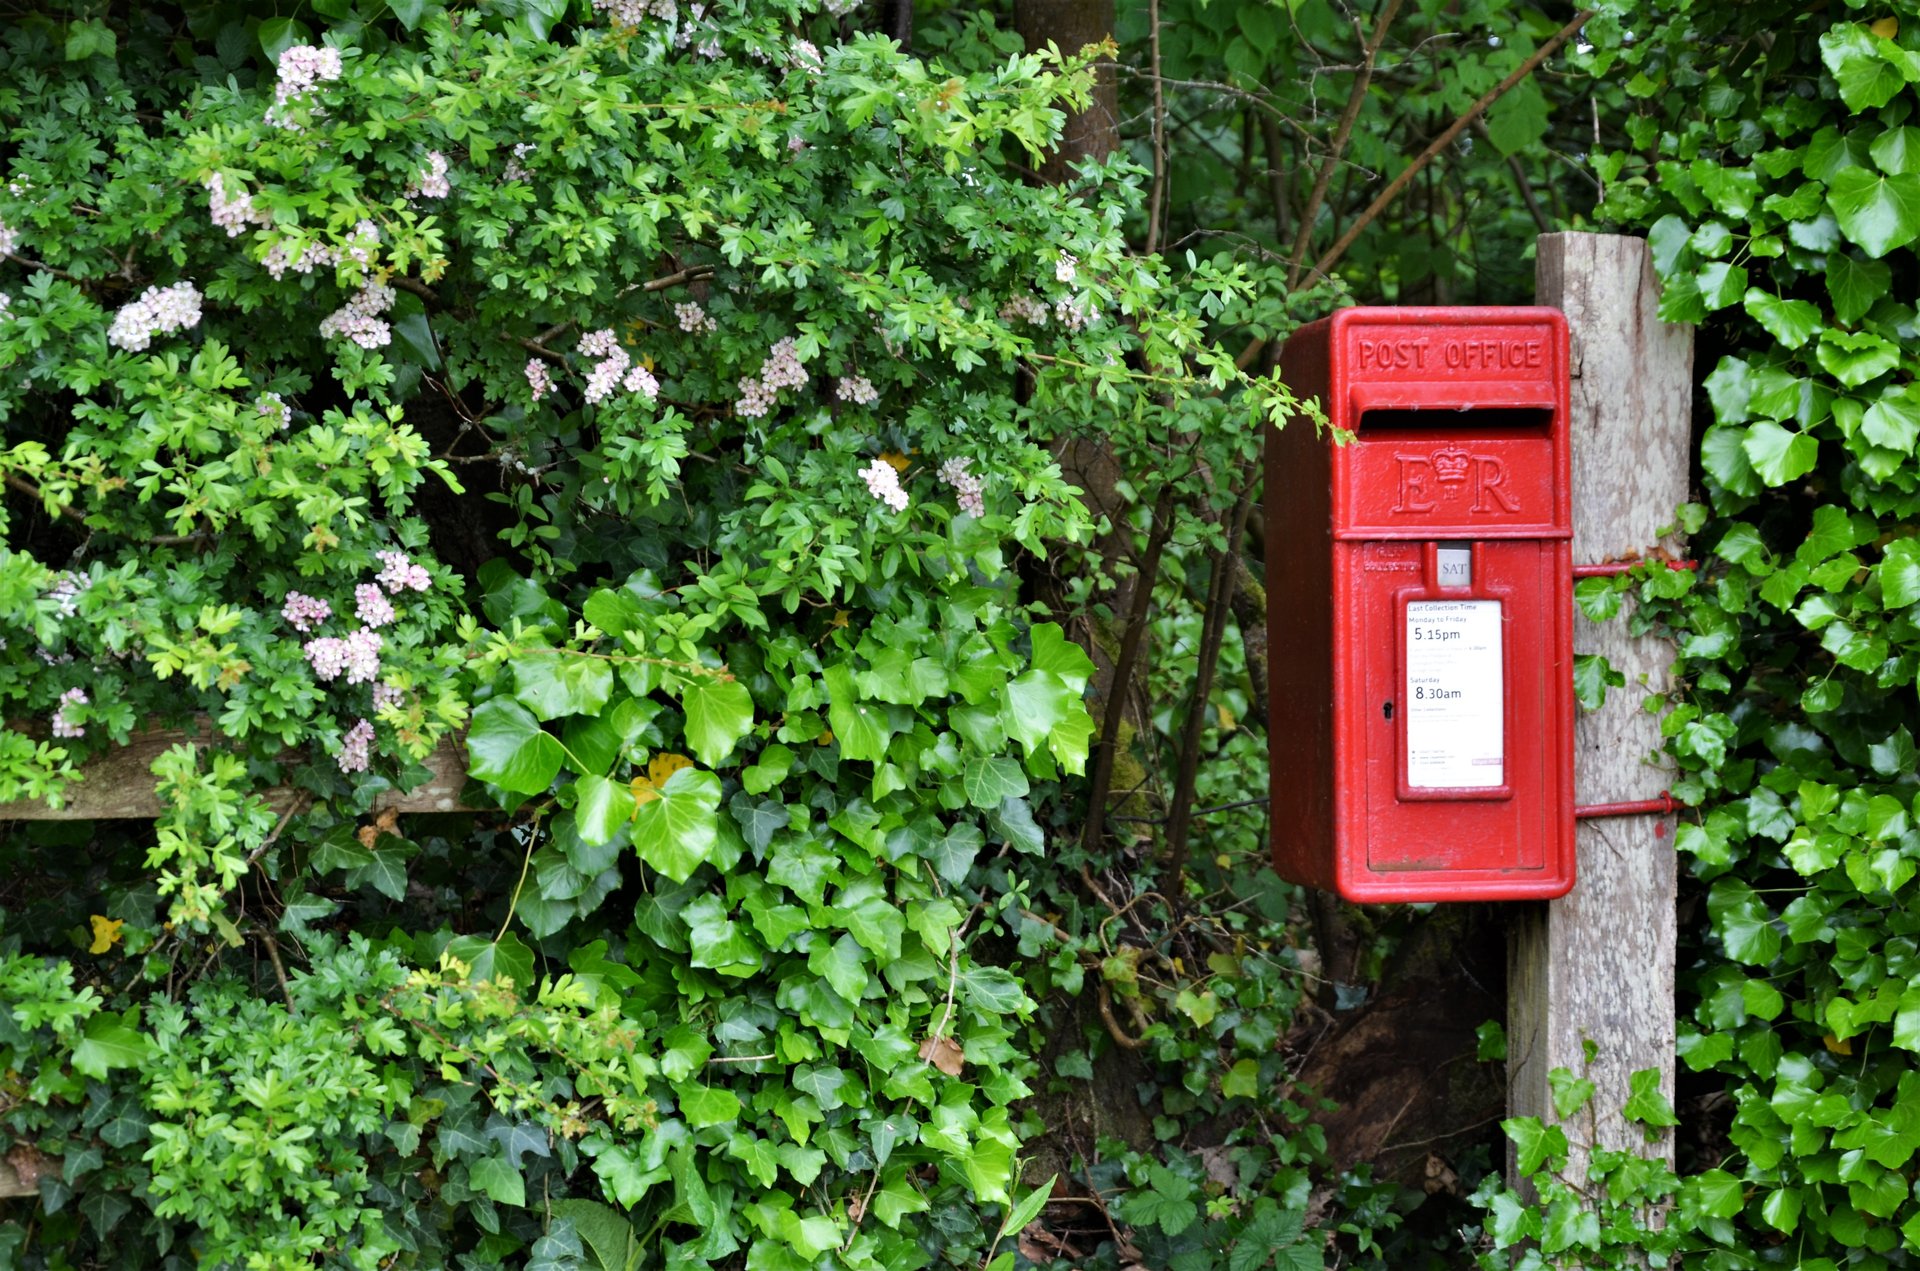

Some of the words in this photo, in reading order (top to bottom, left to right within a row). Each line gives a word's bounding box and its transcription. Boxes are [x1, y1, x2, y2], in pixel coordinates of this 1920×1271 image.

[1358, 340, 1429, 369] POST
[1444, 340, 1541, 369] OFFICE
[1391, 451, 1437, 513] E
[1469, 454, 1521, 513] R
[1442, 562, 1468, 576] SAT
[1425, 604, 1459, 612] Collection
[1460, 603, 1477, 611] Time
[1445, 615, 1467, 623] Friday
[1414, 627, 1461, 642] 5.15pm
[1415, 686, 1462, 700] 8.30am
